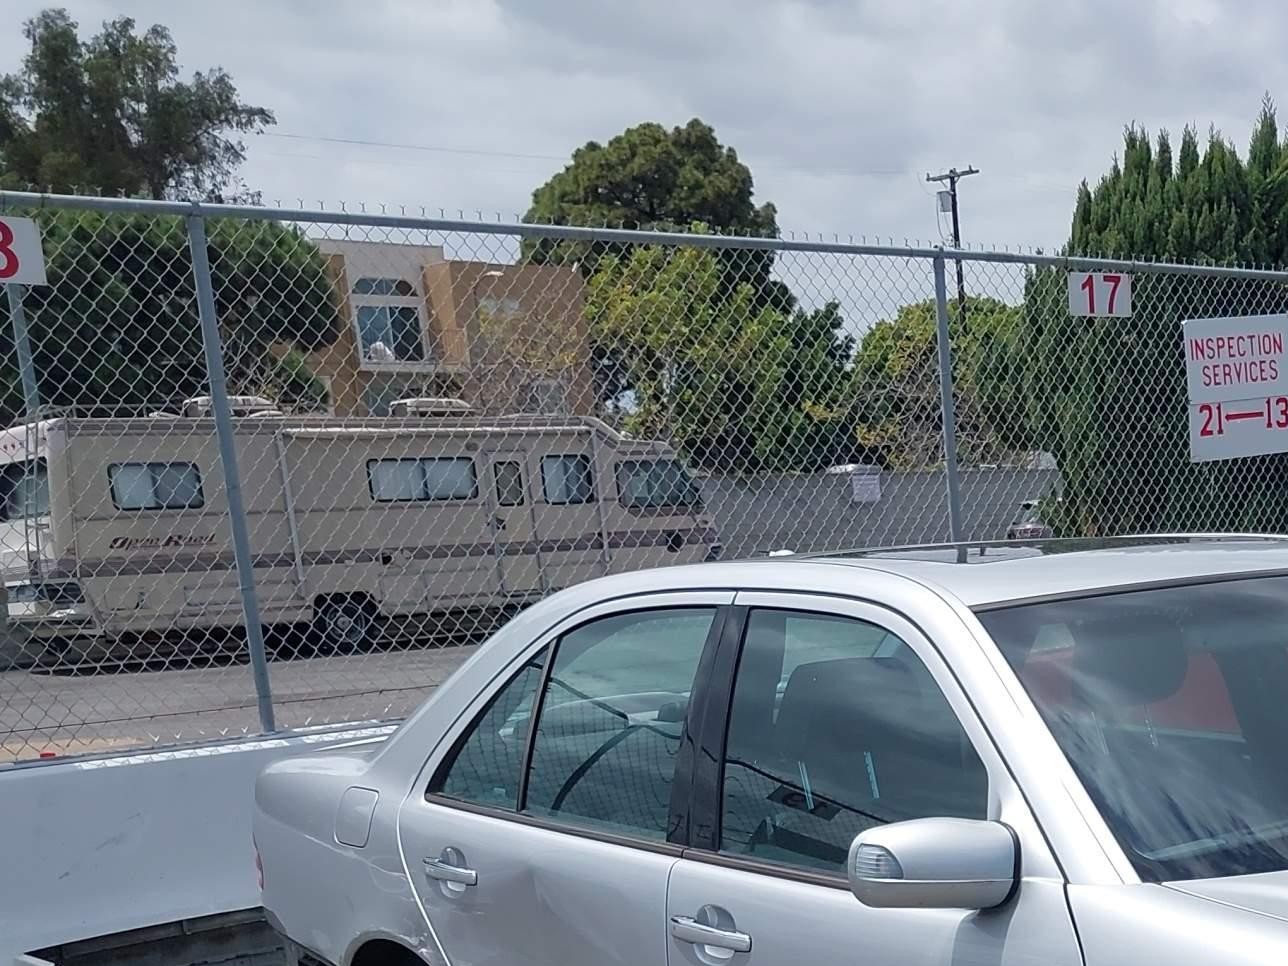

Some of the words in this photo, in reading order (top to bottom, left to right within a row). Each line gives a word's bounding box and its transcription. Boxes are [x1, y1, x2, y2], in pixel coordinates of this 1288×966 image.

[1080, 274, 1122, 315] 17
[1189, 332, 1284, 361] INSPECTION
[1201, 359, 1279, 388] SERVICES
[1199, 403, 1225, 437] 21
